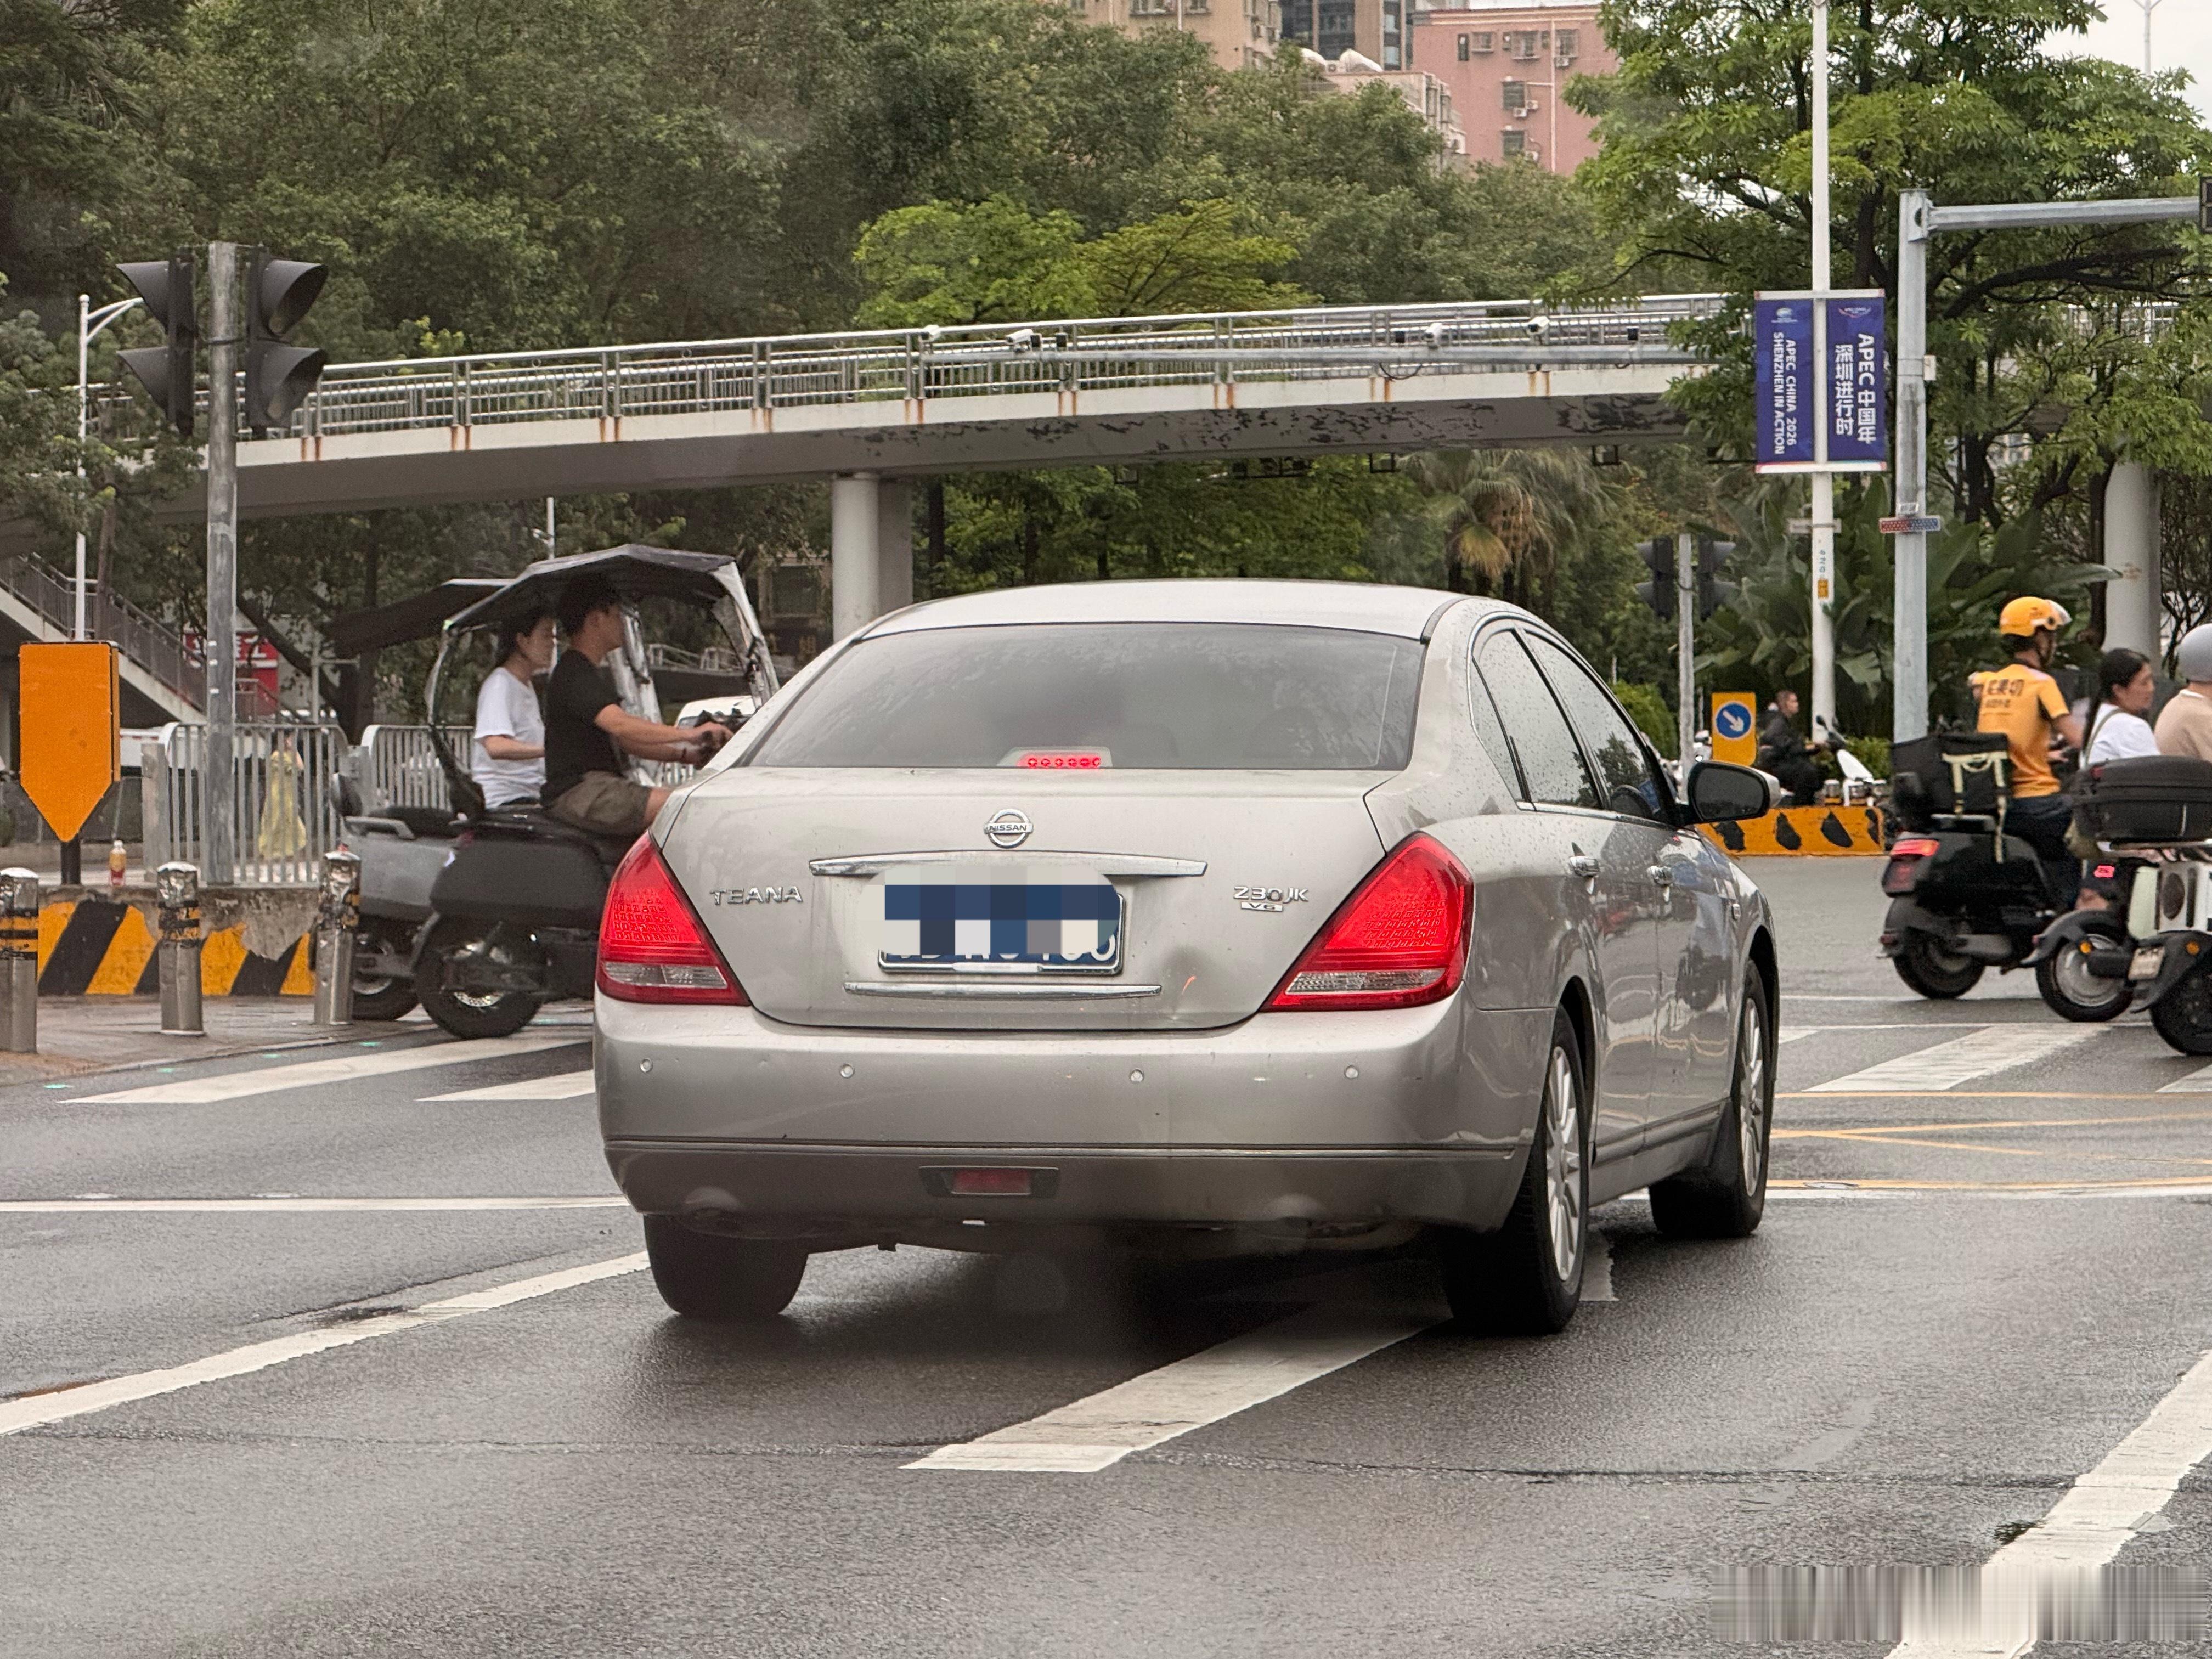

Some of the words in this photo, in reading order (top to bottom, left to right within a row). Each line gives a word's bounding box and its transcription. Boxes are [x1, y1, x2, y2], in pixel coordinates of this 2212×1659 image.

[1773, 332, 1784, 393] SHENZHEN
[1785, 339, 1797, 371] APEC
[1858, 333, 1875, 386] APEC
[1774, 395, 1784, 408] IN
[1785, 375, 1797, 413] CHINA
[1835, 344, 1854, 436] 深圳进行时
[1774, 410, 1785, 454] ACTION
[1786, 417, 1797, 446] 2026
[1857, 389, 1876, 444] 中国年
[709, 886, 803, 906] TEANA
